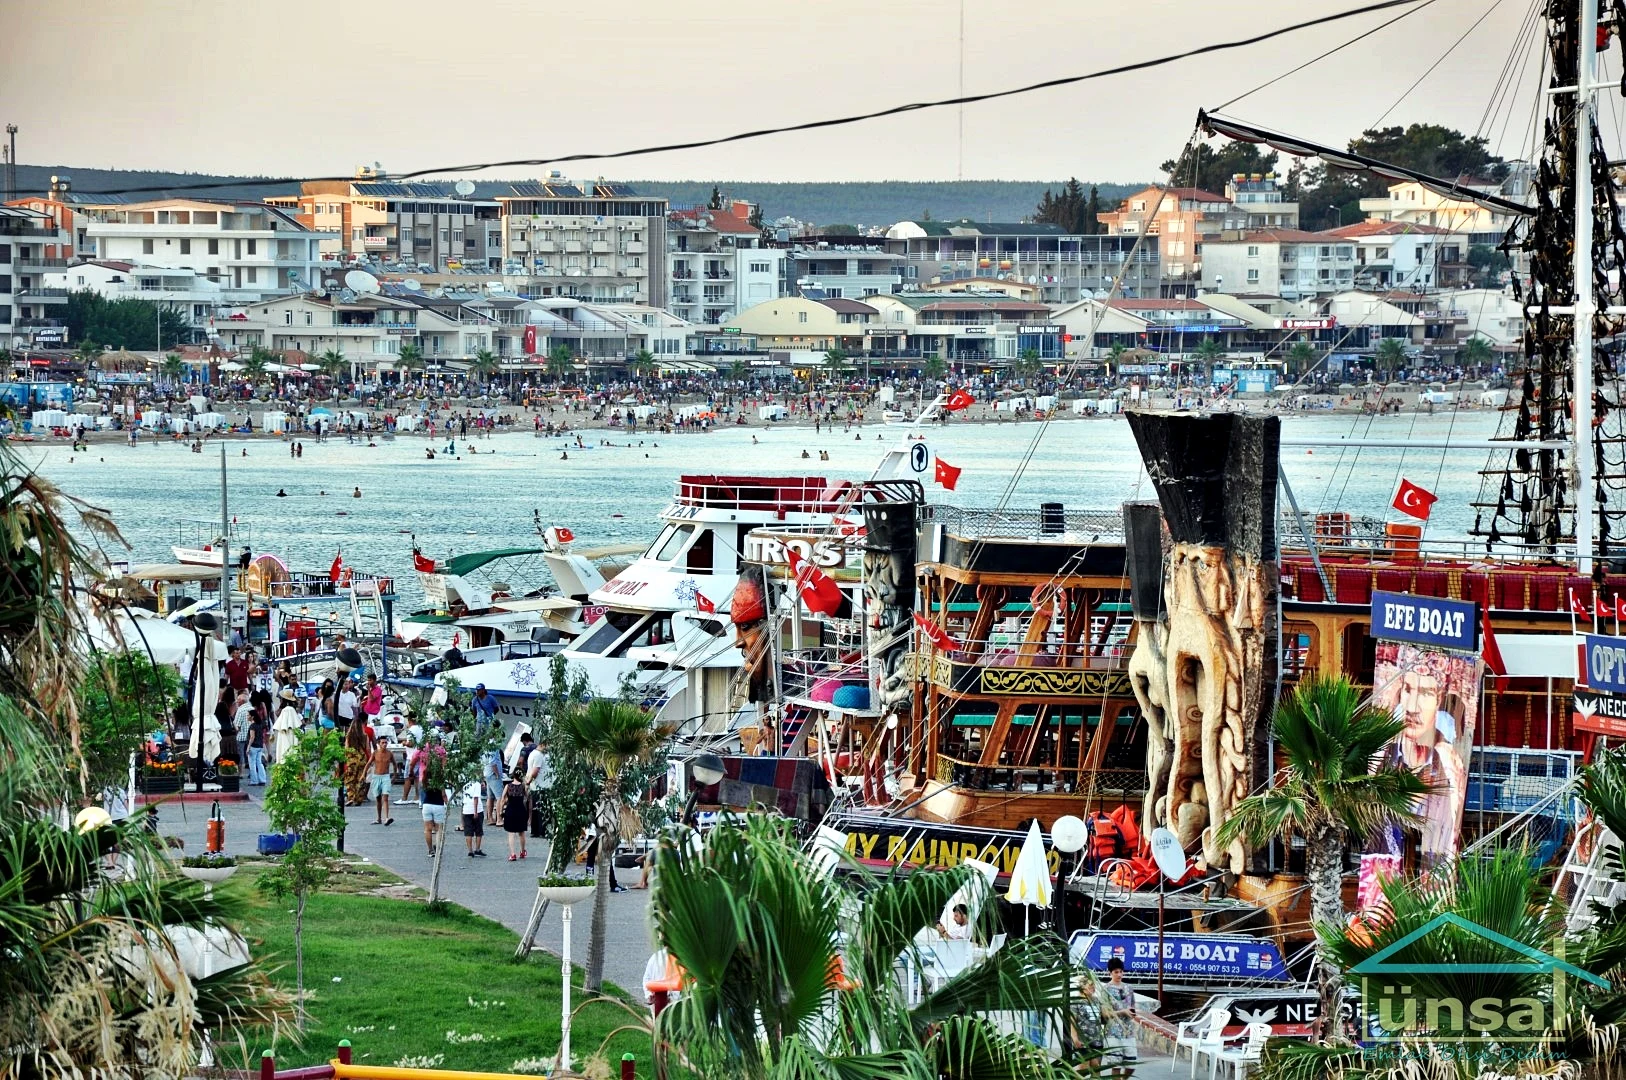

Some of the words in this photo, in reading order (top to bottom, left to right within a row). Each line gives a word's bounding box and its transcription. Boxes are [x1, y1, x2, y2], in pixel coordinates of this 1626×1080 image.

[1383, 602, 1415, 632] EFE
[1418, 607, 1465, 638] BOAT
[260, 677, 273, 691] 99
[1134, 941, 1175, 958] EFE
[1179, 943, 1239, 962] BOAT
[1131, 961, 1149, 969] 0539
[1173, 963, 1183, 971] 42
[1189, 963, 1207, 972] 0554
[1208, 964, 1221, 973] 907
[1221, 965, 1231, 973] 53
[1231, 966, 1241, 974] 23
